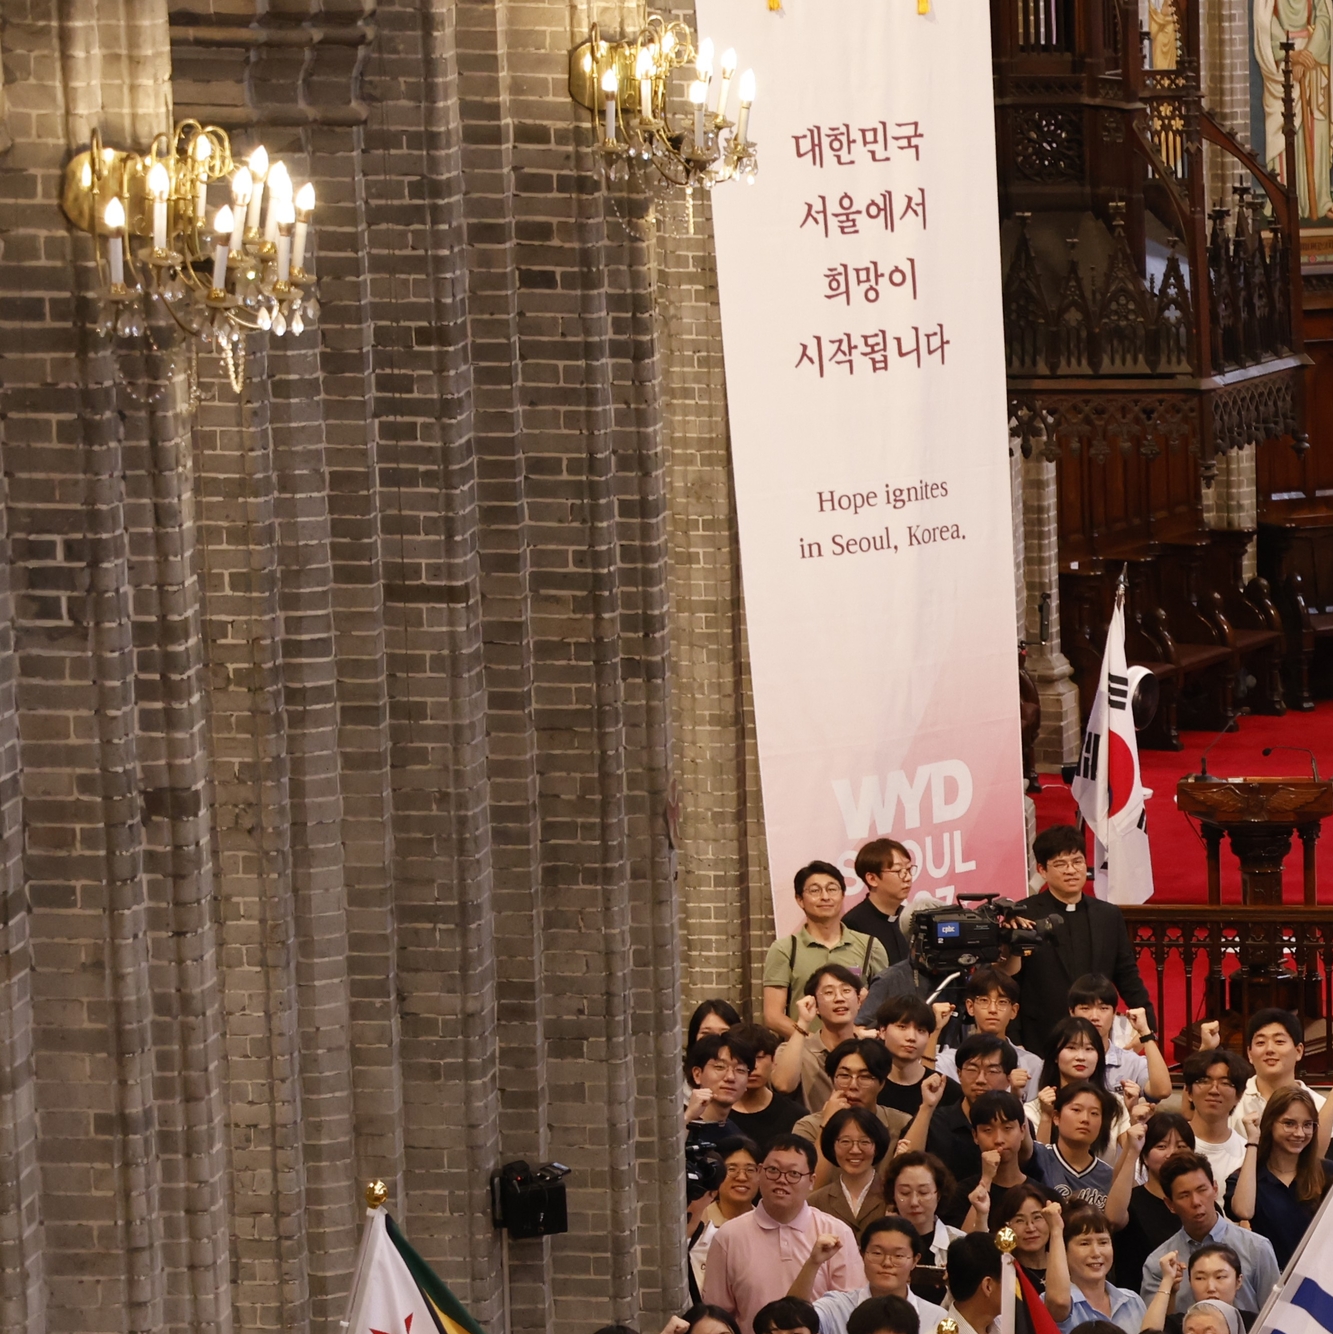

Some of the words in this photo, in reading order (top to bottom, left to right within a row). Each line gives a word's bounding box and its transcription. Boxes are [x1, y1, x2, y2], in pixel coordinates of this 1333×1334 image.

[791, 121, 924, 168] 대한민국
[800, 188, 926, 238] 서울에서
[824, 258, 917, 306] 희망이
[795, 323, 950, 378] 시작됩니다
[817, 491, 877, 514] Hope
[885, 480, 948, 509] ignites
[800, 538, 823, 558] in
[832, 527, 898, 555] Seoul,
[907, 524, 965, 546] Korea.
[831, 759, 973, 840] WYD
[837, 830, 977, 896] SOUL
